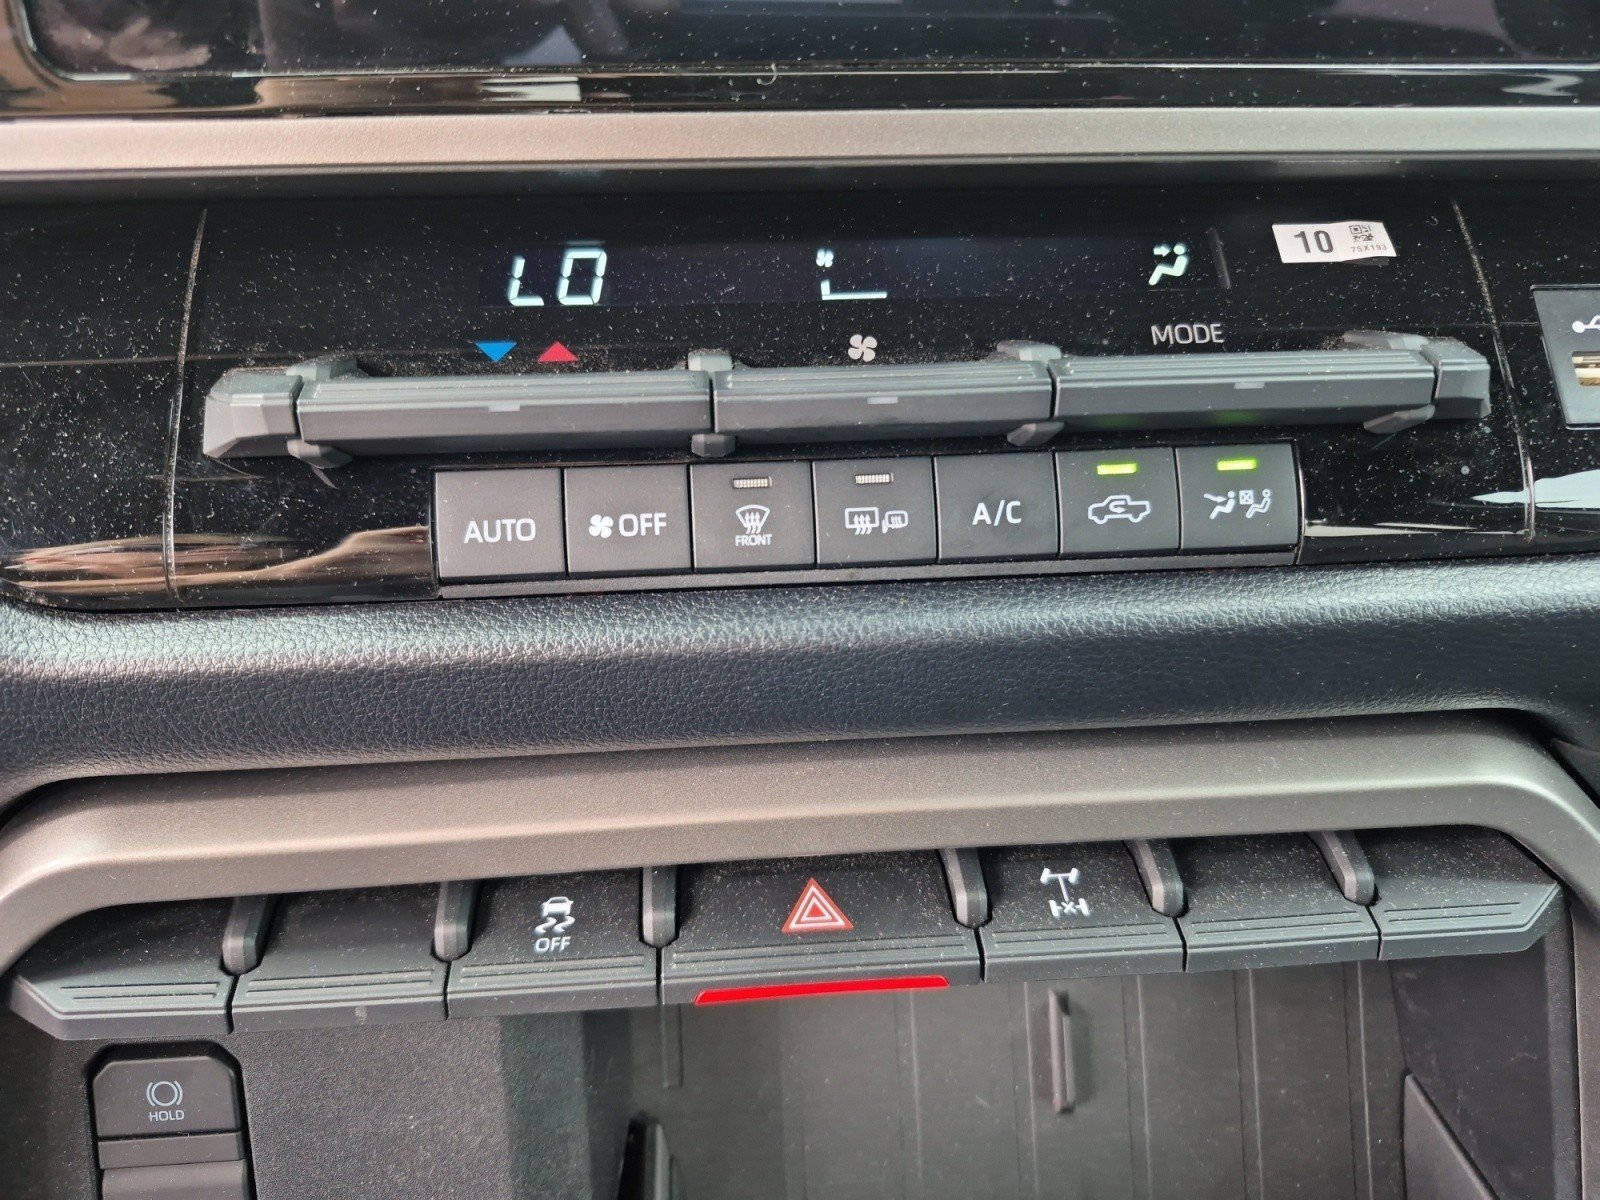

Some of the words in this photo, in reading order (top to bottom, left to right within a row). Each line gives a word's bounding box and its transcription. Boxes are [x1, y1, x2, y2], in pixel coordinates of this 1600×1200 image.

[1294, 230, 1334, 253] 10
[1150, 323, 1225, 345] MODE
[971, 499, 1022, 527] A/C
[464, 518, 537, 543] AUTO
[618, 512, 667, 537] OFF
[734, 533, 773, 547] FRONT
[533, 936, 571, 954] OFF
[148, 1109, 185, 1122] HOLD
